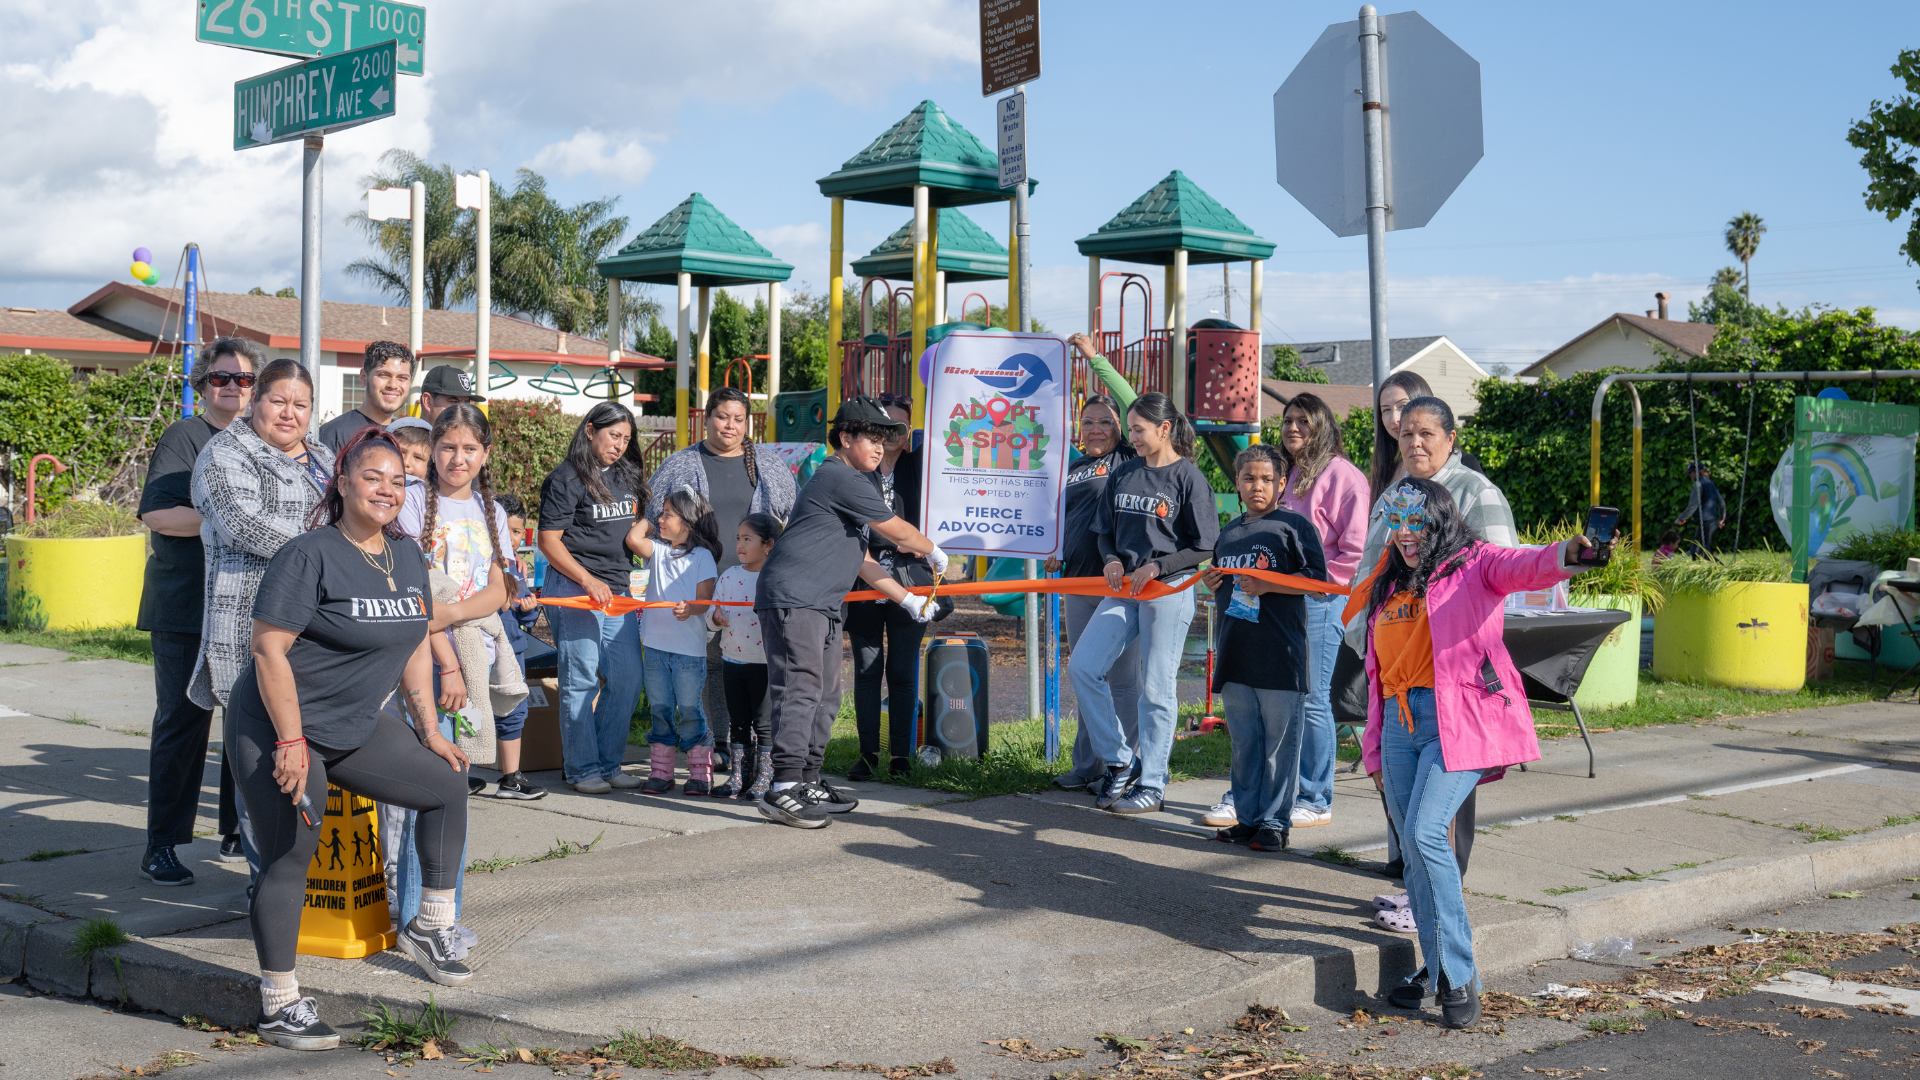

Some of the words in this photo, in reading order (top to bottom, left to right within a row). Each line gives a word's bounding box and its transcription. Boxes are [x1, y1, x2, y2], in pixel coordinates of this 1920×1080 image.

[987, 10, 997, 18] Dogs
[987, 16, 999, 27] Leash
[306, 0, 360, 51] ST
[369, 4, 420, 37] 1000
[988, 28, 997, 37] Pick
[1004, 22, 1014, 30] After
[1015, 18, 1025, 26] Your
[1026, 14, 1034, 22] Dog
[995, 29, 1015, 42] Motorized
[1016, 24, 1032, 34] Vehicles
[1004, 38, 1016, 49] Quiet
[352, 50, 390, 83] 2600
[237, 65, 337, 138] HUMPHREY
[336, 89, 364, 119] AVE
[1006, 100, 1016, 112] NO
[1002, 110, 1019, 123] Animal
[1004, 122, 1019, 133] Waste
[1002, 143, 1022, 156] Animals
[1002, 154, 1022, 166] Without
[1005, 164, 1020, 175] Leash
[944, 366, 1025, 376] Richmond
[1816, 406, 1864, 426] HUMPHREY
[1868, 411, 1908, 430] PLAYLOT
[944, 430, 964, 447] A
[972, 431, 1044, 450] SPOT
[1858, 435, 1876, 458] Day
[1067, 467, 1096, 483] ERCE
[964, 489, 1011, 498] ADPTED
[1014, 490, 1029, 498] BY:
[592, 500, 633, 518] FIERCE
[966, 507, 1022, 520] FIERCE
[938, 520, 1045, 536] ADVOCATES
[1217, 553, 1256, 569] ERCE
[1252, 544, 1277, 568] ADVOCATES
[351, 597, 422, 617] FIERCE
[949, 699, 967, 710] JBL
[327, 796, 341, 811] WN
[352, 795, 372, 811] DOWN
[306, 878, 347, 892] CHILDREN
[352, 872, 384, 892] CHILDREN
[303, 894, 346, 910] PLAYING
[354, 887, 386, 910] PLAYING
